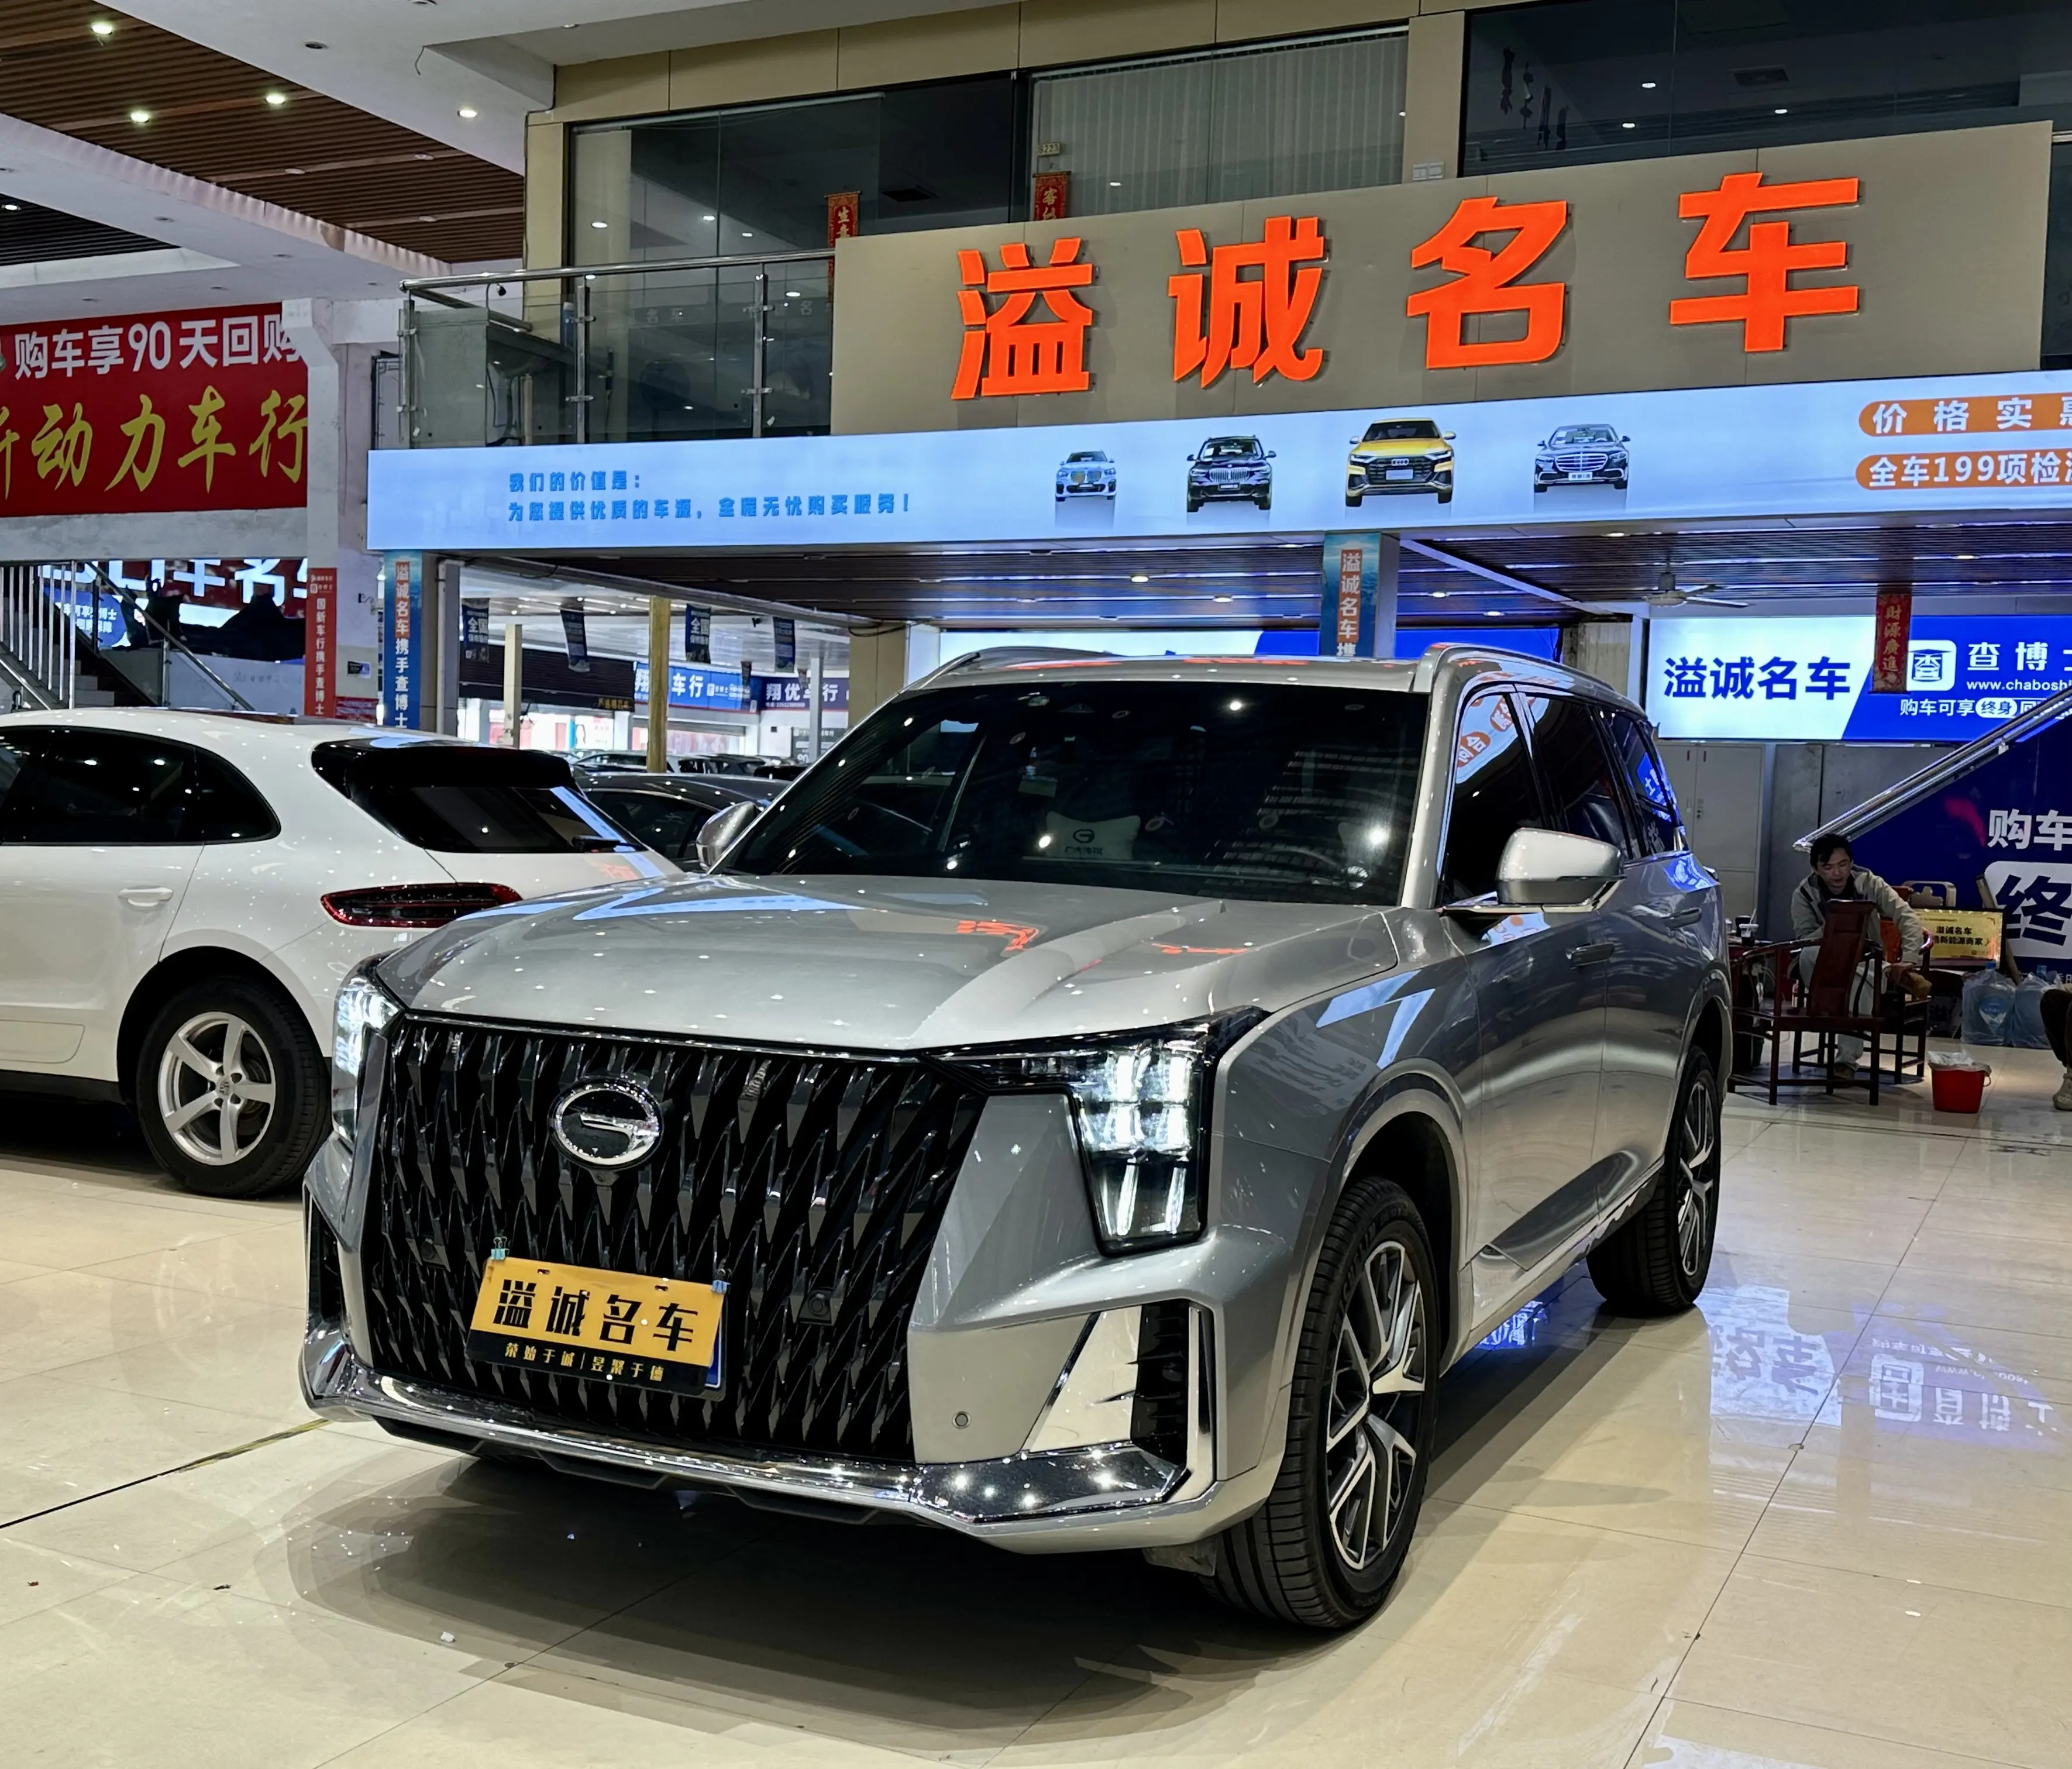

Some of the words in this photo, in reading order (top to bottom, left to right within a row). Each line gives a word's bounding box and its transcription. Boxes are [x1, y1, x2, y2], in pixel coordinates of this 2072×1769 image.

[951, 173, 1859, 400] 溢诚名车
[15, 314, 302, 381] 购车享90天回购
[1869, 451, 2072, 487] 全车199项检
[1664, 656, 1851, 701] 溢诚名车
[1967, 642, 2072, 671] 查博
[1987, 808, 2072, 851] 购车
[1995, 874, 2072, 947] 终
[493, 1278, 698, 1352] 溢诚名车
